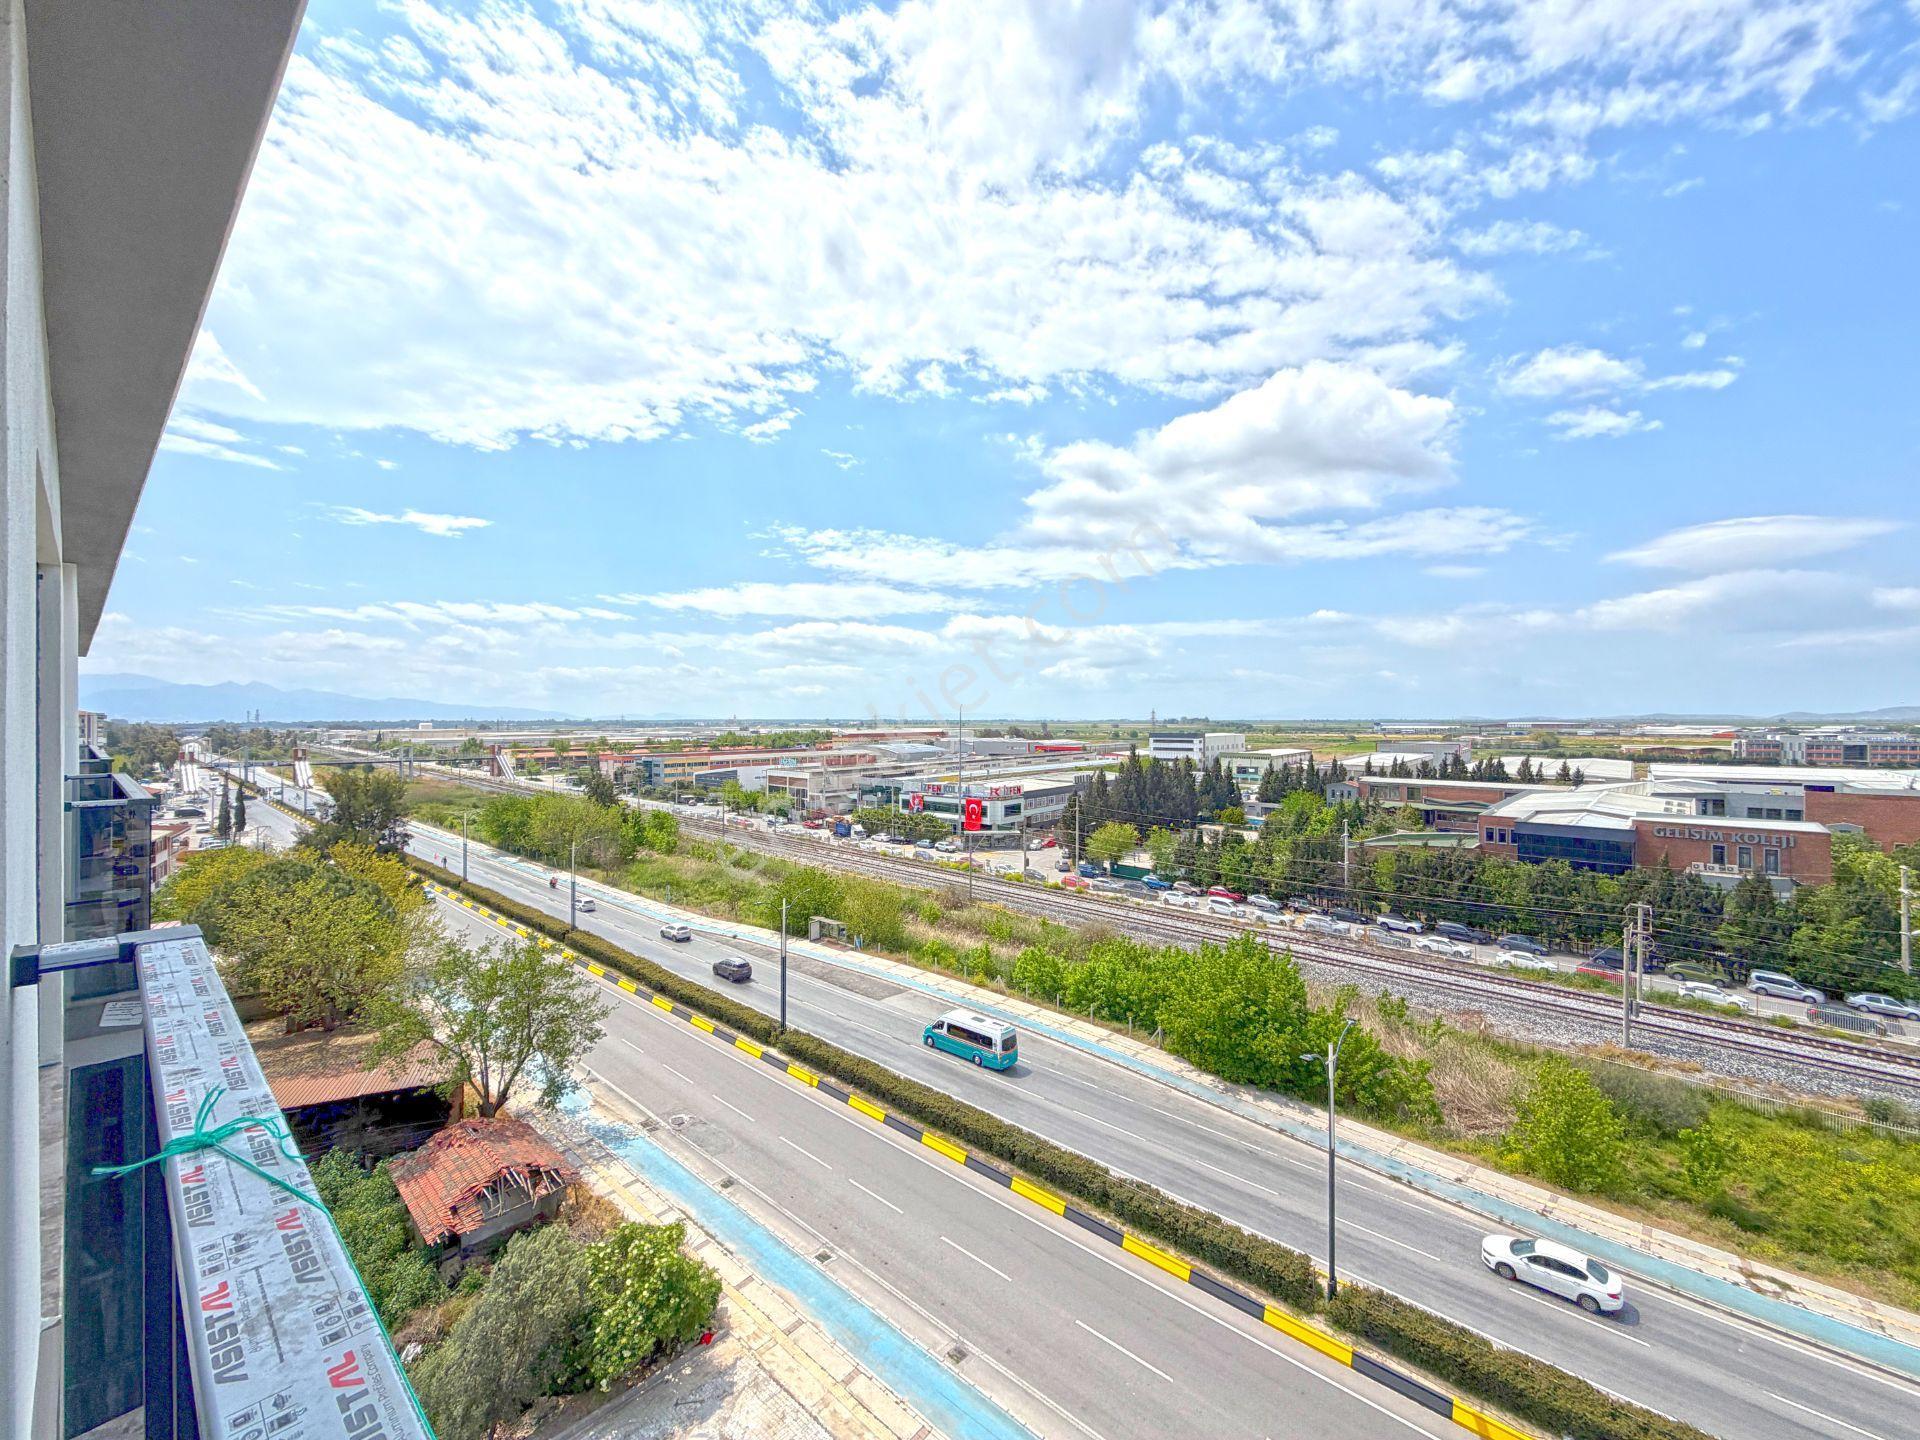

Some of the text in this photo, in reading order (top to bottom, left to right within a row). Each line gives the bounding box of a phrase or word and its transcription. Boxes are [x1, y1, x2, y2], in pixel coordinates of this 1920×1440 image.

[243, 1126, 280, 1168] ASISTA
[180, 1165, 216, 1228] ASISTAL
[275, 1207, 326, 1284] ASISTAL
[200, 1280, 249, 1385] ASISTAL
[326, 1350, 389, 1440] ISTAL
